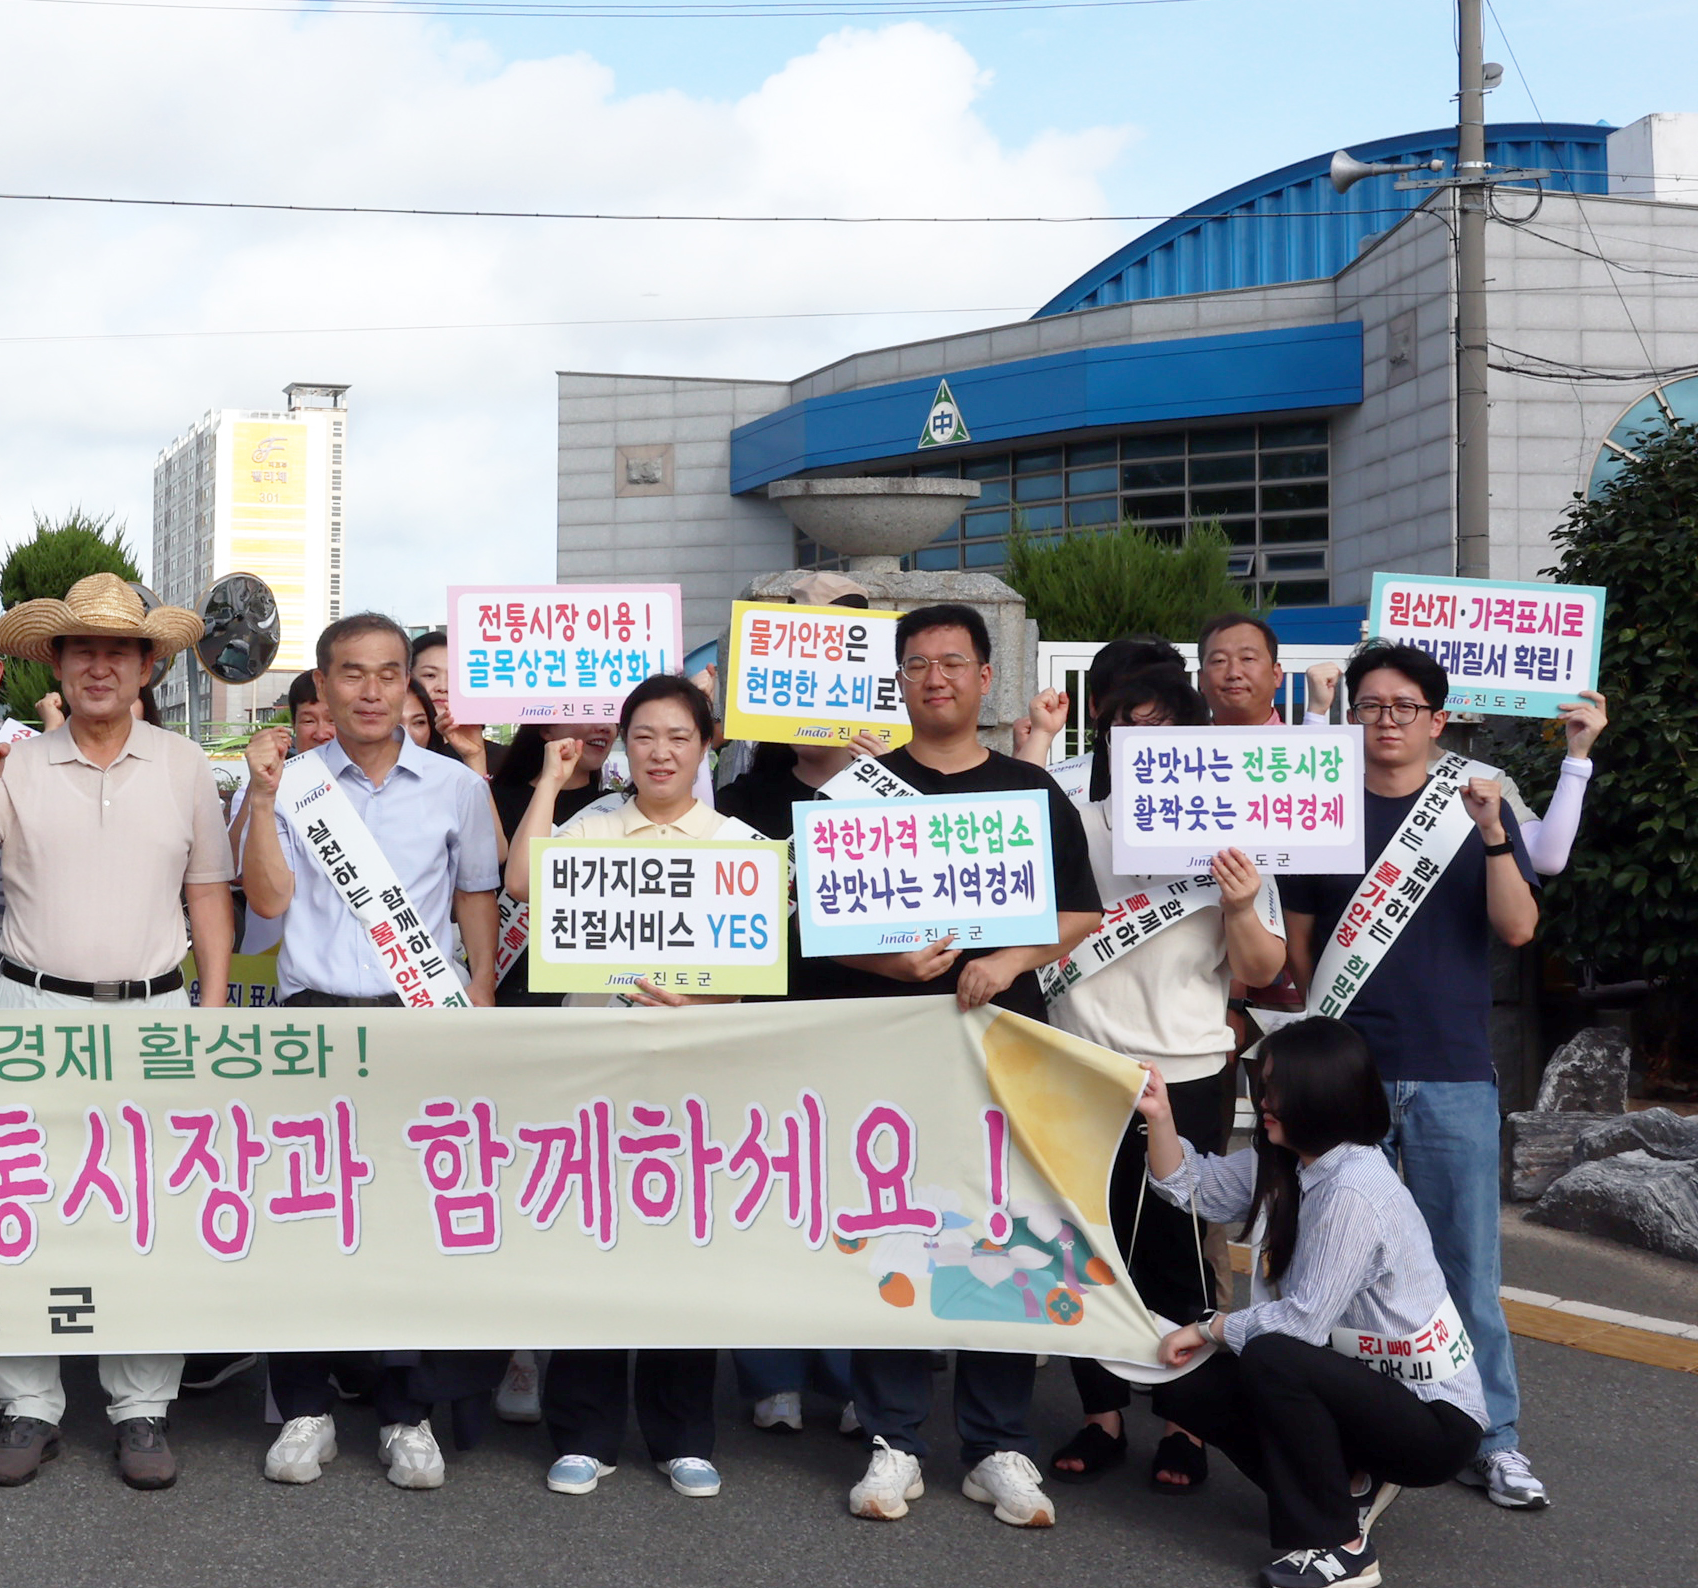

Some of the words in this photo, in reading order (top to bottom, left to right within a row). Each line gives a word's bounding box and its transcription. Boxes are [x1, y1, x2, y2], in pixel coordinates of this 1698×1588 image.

[259, 492, 279, 503] 301
[477, 602, 580, 644] 전통시장
[586, 602, 636, 642] 이용
[749, 619, 869, 663] 물가안정은
[466, 649, 567, 689] 골목상권
[574, 647, 650, 687] 활성화
[1513, 645, 1560, 682] 확립
[745, 665, 818, 708] 현명한
[1132, 746, 1234, 784] 살맛나는
[1242, 745, 1344, 784] 전통시장
[1132, 794, 1237, 831] 활짝웃는
[1246, 793, 1345, 831] 지역경제
[813, 814, 919, 863] 착한가격
[927, 811, 1035, 858] 착한업소
[305, 818, 374, 910] 실천하는
[552, 856, 696, 899] 바가지요금
[714, 859, 760, 897] NO
[816, 867, 923, 916] 살맛나는
[932, 860, 1036, 908] 지역경제
[1336, 860, 1403, 948] 물가안정
[1367, 855, 1441, 945] 함께하는
[379, 884, 447, 979] 함께하는
[550, 908, 696, 951] 친절서비스
[707, 912, 768, 950] YES
[1092, 898, 1185, 962] 함께하는
[138, 1022, 334, 1082] 활성화
[404, 1092, 940, 1250] 함께하세요
[1358, 1318, 1449, 1357] 전통시장
